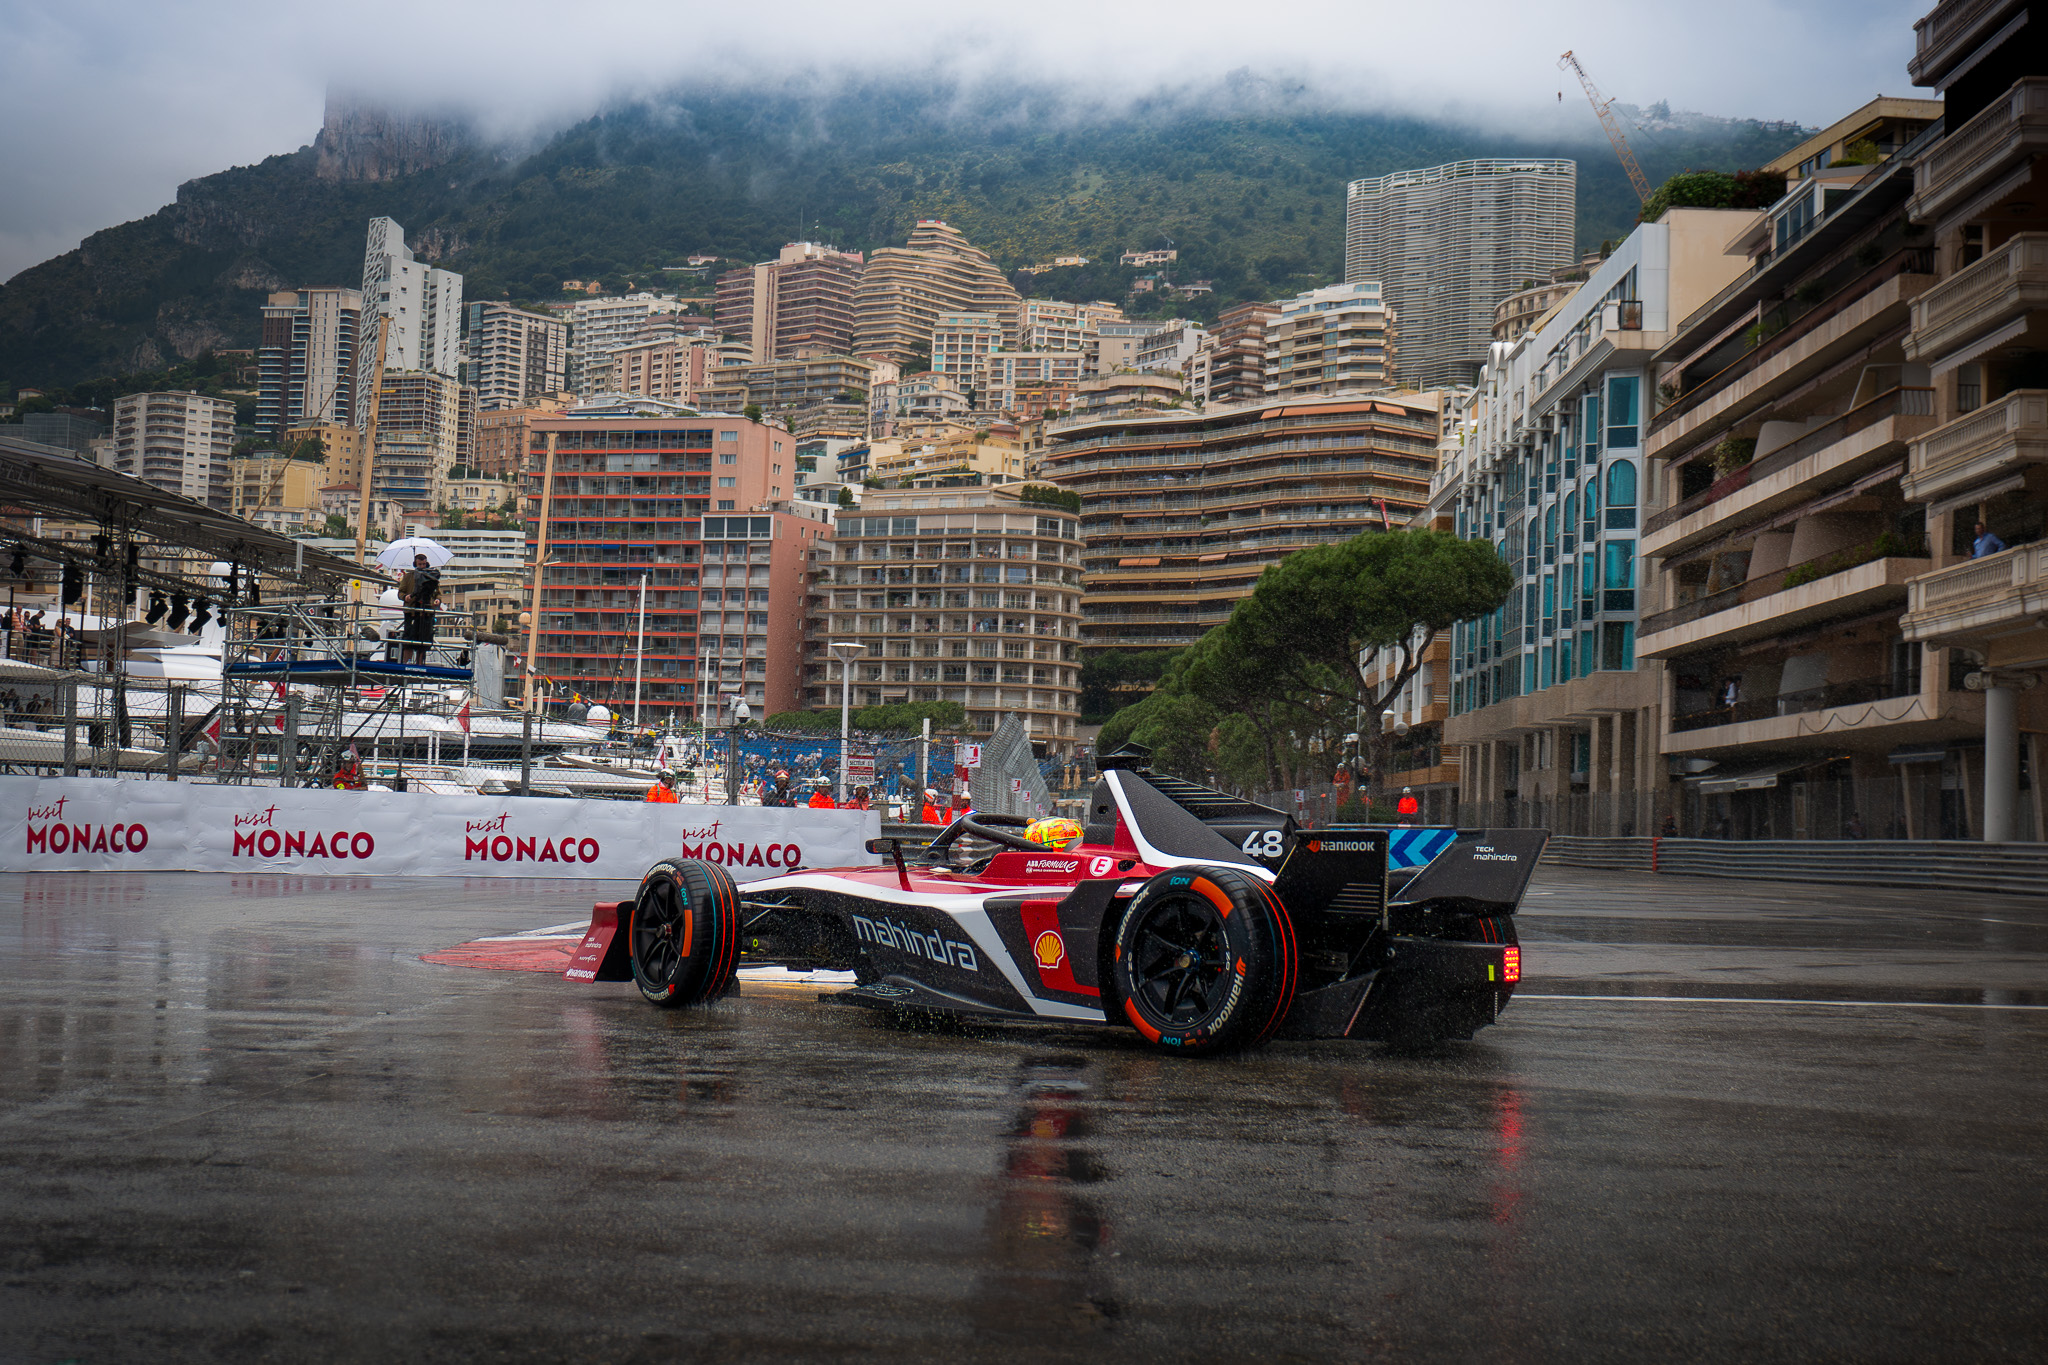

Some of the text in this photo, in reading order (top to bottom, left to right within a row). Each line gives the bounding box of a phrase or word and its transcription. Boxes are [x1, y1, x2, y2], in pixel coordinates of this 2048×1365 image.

[28, 796, 68, 821] visit
[234, 805, 280, 827] visit
[466, 812, 512, 833] visit
[683, 819, 723, 840] visit
[27, 823, 148, 854] MONACO
[232, 829, 375, 859] MONACO
[465, 835, 600, 864] MONACO
[1242, 830, 1283, 858] 48
[682, 841, 802, 868] MONACO
[1473, 853, 1518, 861] mahindra
[852, 914, 978, 971] mahindra
